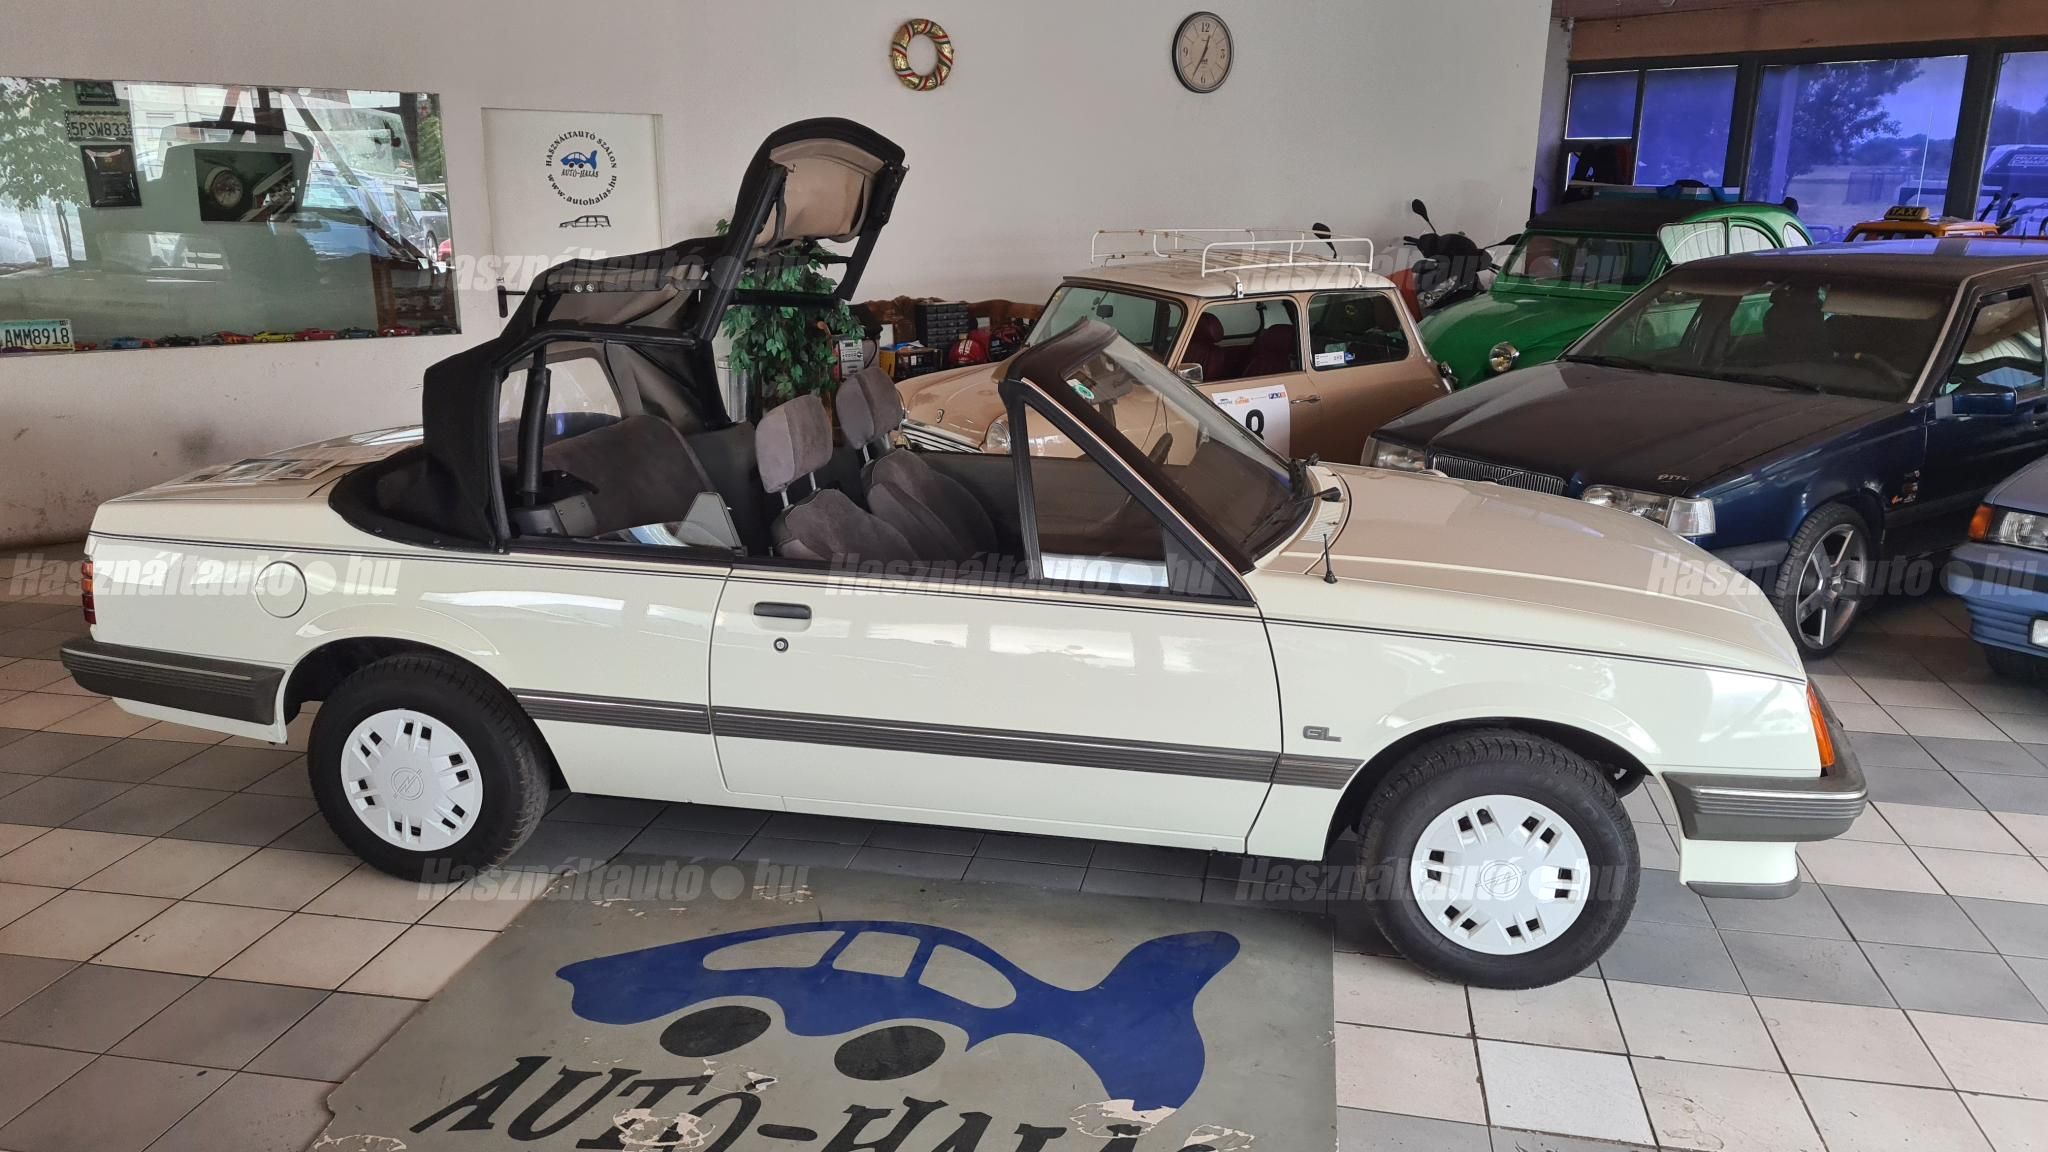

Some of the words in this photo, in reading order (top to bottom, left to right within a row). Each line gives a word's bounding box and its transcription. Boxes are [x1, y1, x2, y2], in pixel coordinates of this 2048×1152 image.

[1201, 22, 1210, 33] 12
[70, 121, 129, 137] 5PSW833
[545, 130, 597, 167] HASZNÁLTAUTÓ
[596, 138, 618, 169] SZALON
[547, 174, 618, 206] www.autohalas.hu
[1892, 207, 1921, 217] TAXI
[5, 328, 70, 348] AMM8918
